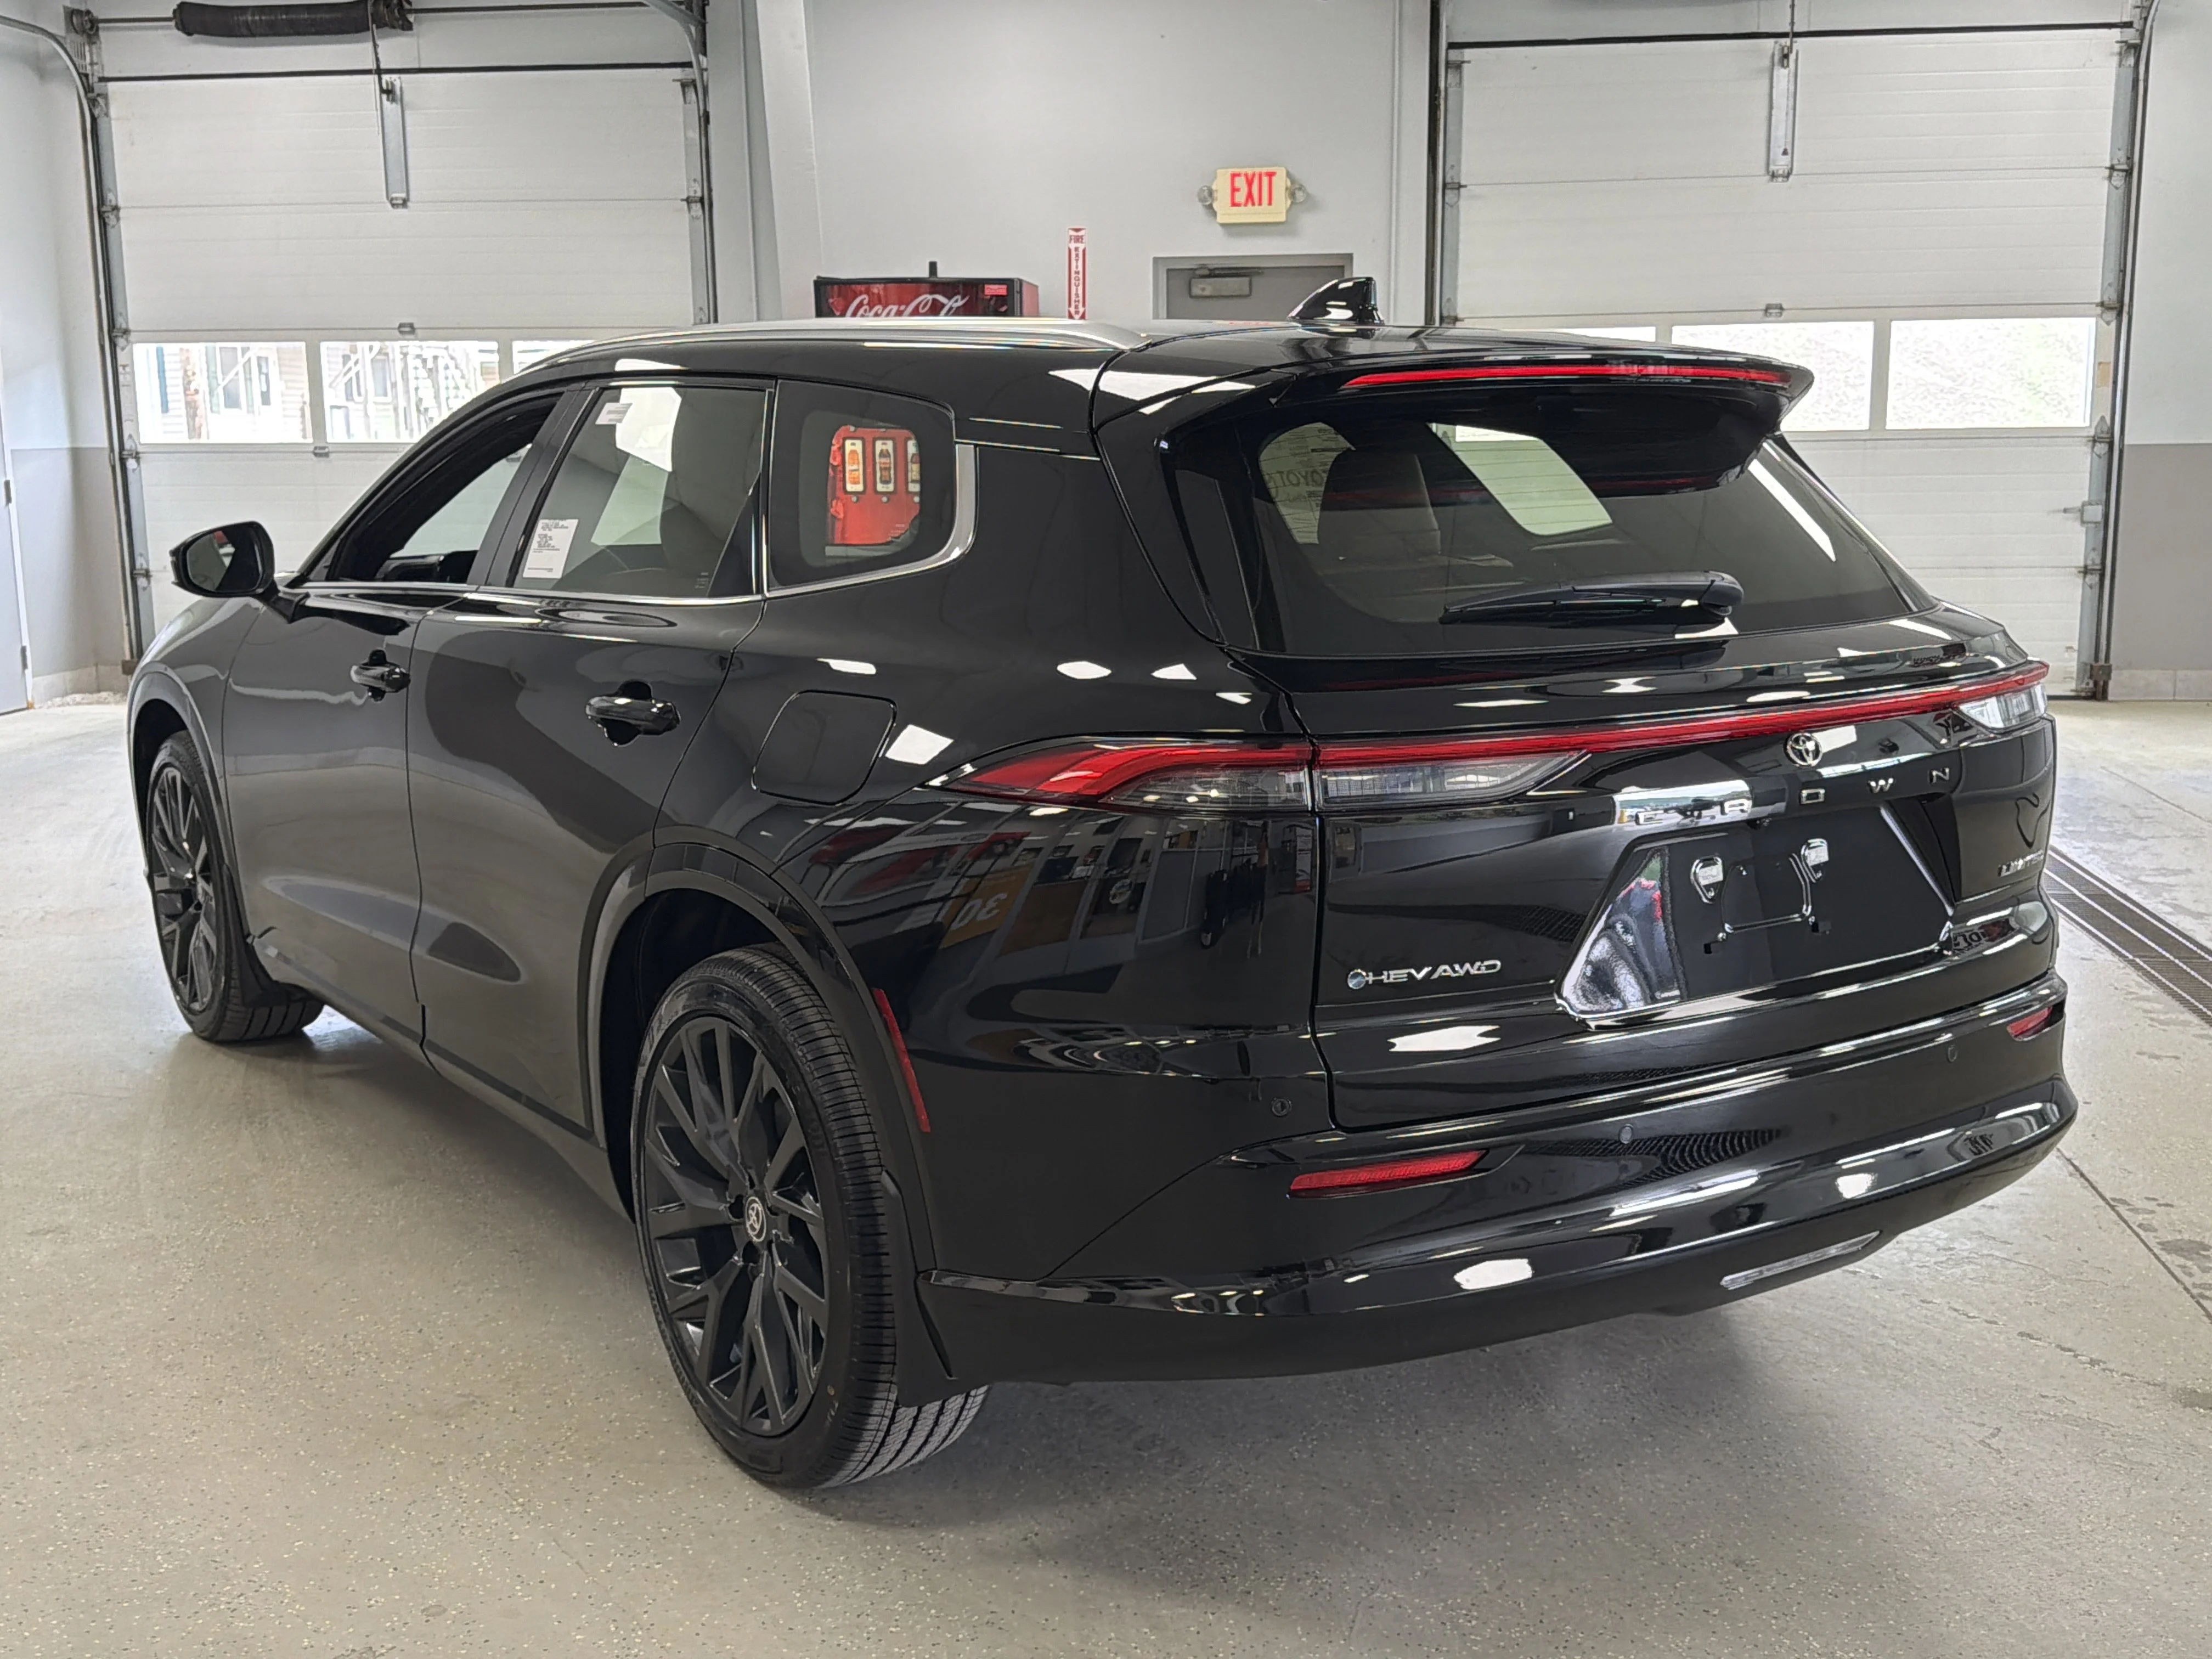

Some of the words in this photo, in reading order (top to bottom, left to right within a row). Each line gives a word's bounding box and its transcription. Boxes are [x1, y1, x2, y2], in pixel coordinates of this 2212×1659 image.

[1229, 171, 1277, 207] EXIT
[1070, 235, 1085, 244] FIRE
[845, 294, 969, 317] Coca-Cl
